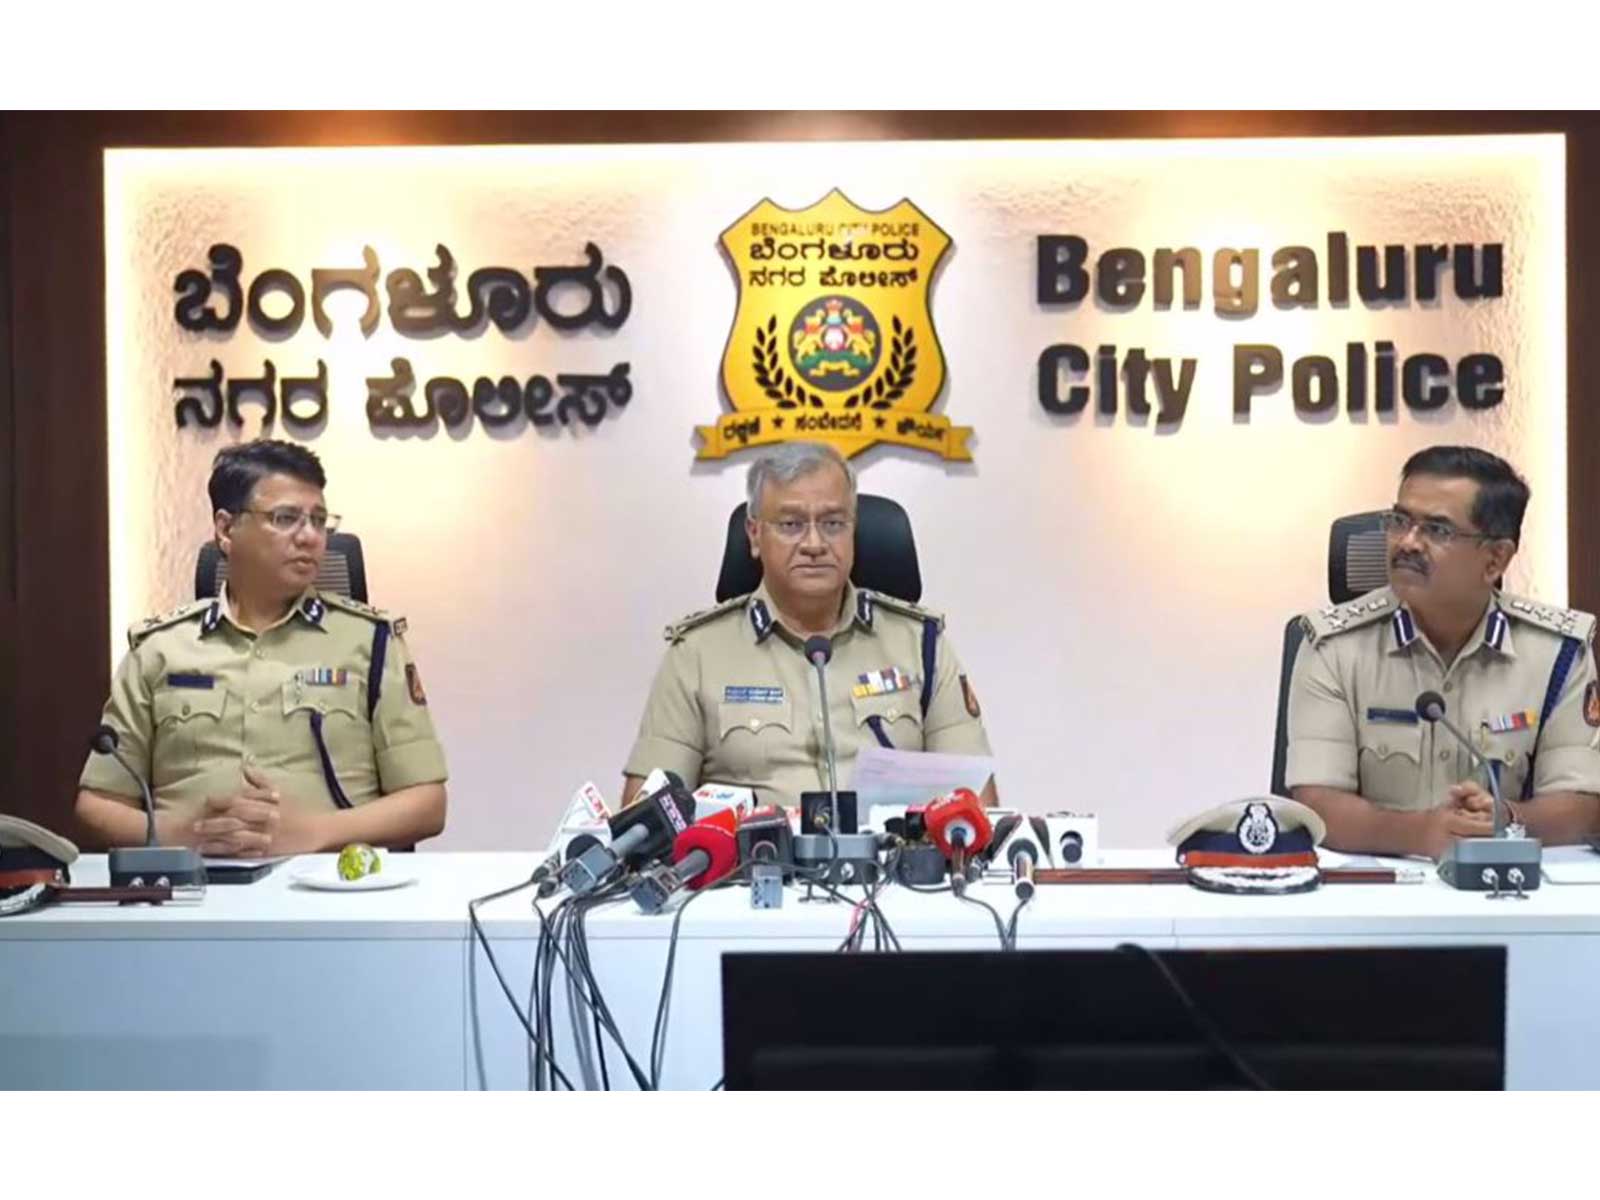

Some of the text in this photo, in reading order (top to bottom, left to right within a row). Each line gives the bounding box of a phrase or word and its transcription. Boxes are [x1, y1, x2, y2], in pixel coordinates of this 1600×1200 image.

[749, 236, 919, 261] ಬೆಂಗಳೂರು
[751, 222, 834, 236] BENGALURU
[871, 222, 920, 236] POLICE
[173, 241, 633, 339] ಬೆಂಗಳೂರು
[749, 265, 918, 287] ನಗರ ಪೊಲೀಸ್
[1036, 231, 1504, 318] Bengaluru
[173, 357, 633, 429] ನಗರ ಪೊಲೀಸ್
[1037, 341, 1504, 425] City Police
